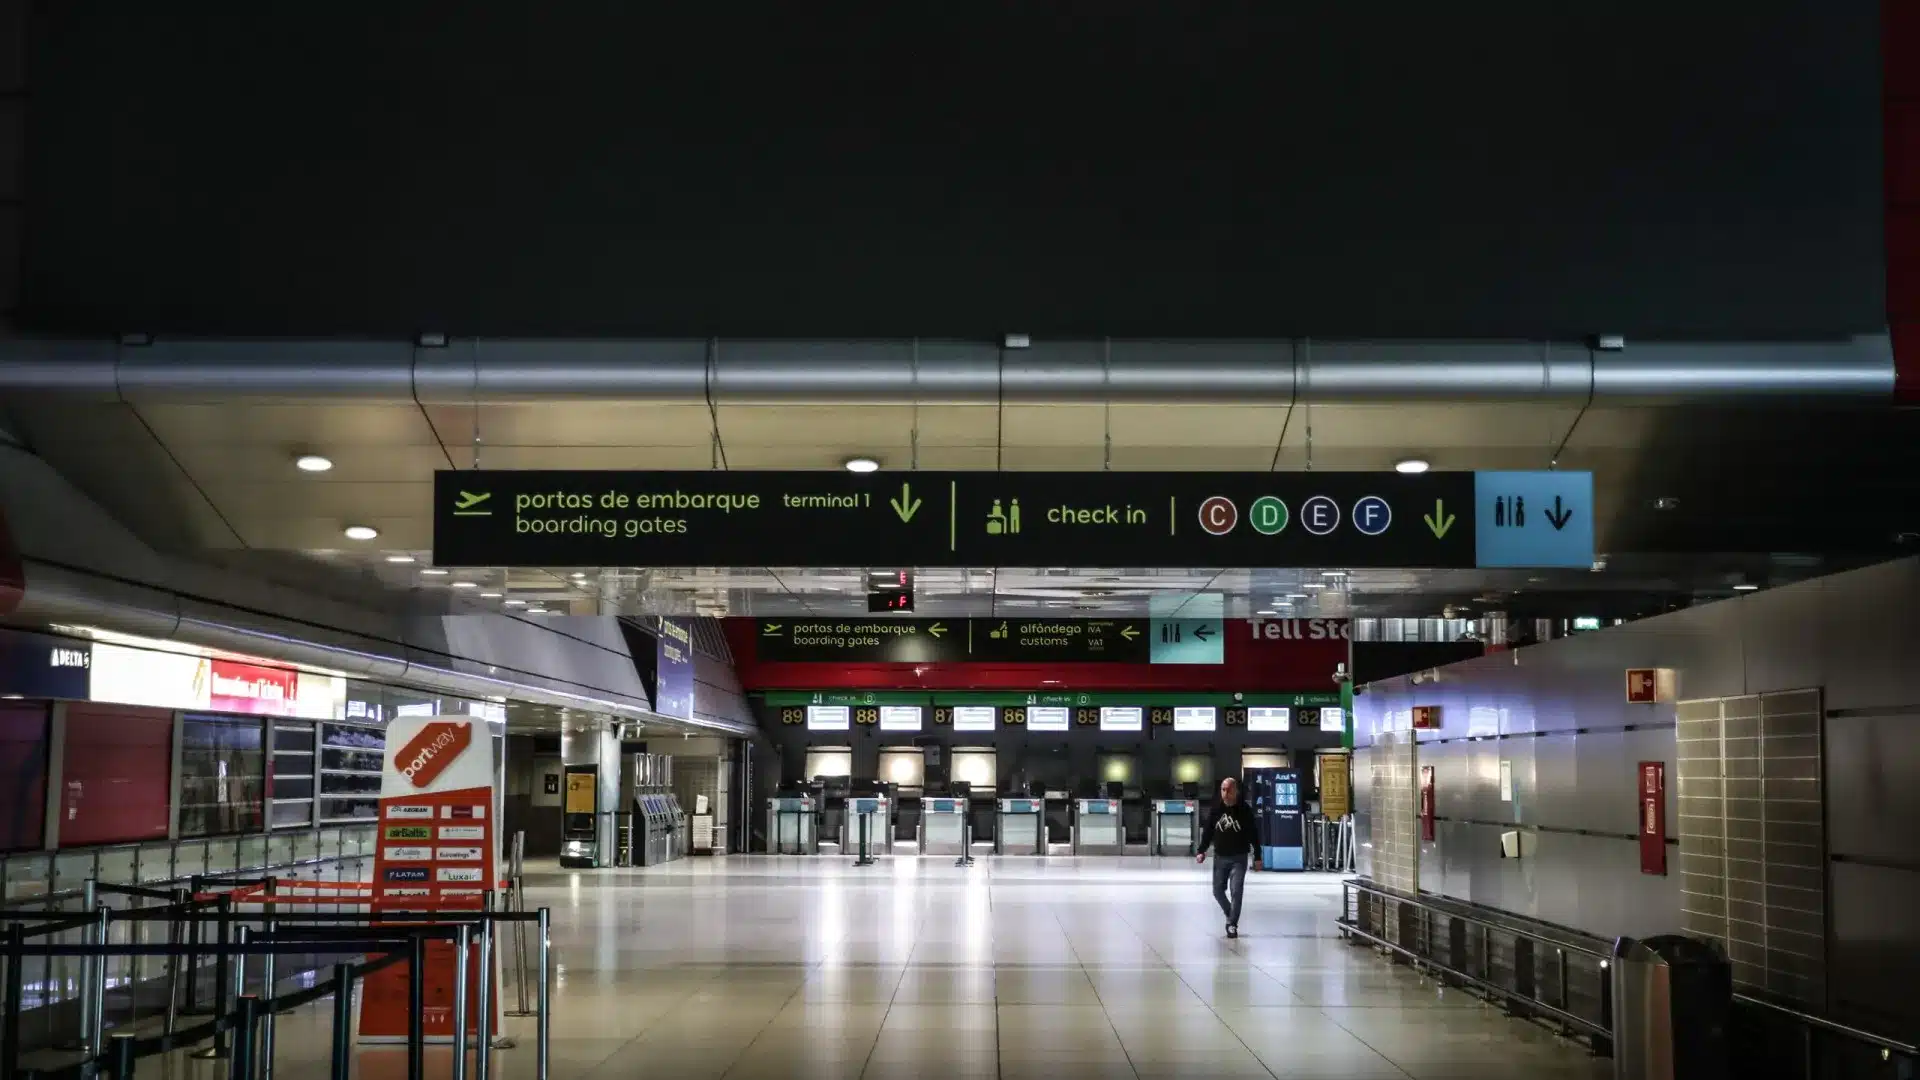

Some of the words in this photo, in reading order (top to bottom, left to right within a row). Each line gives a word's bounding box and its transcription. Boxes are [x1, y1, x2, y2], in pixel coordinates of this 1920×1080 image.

[515, 491, 593, 512] portas
[600, 490, 629, 509] de
[636, 490, 760, 513] embarque
[783, 493, 860, 508] terminal
[863, 493, 871, 508] 1
[1047, 505, 1118, 524] check
[1126, 504, 1146, 524] in
[1210, 505, 1228, 526] C
[1262, 505, 1278, 526] D
[1313, 505, 1328, 526] E
[1365, 505, 1380, 526] F
[515, 515, 618, 537] boarding
[624, 516, 687, 537] gates
[794, 624, 832, 636] portas
[836, 622, 850, 634] de
[854, 622, 916, 637] embarque
[1020, 622, 1081, 637] alfândega
[1247, 618, 1302, 640] Tell
[794, 636, 845, 648] boarding
[848, 637, 880, 648] gates
[1020, 636, 1068, 647] customs
[1088, 638, 1103, 646] VAT
[60, 652, 83, 667] DELTA
[782, 709, 803, 724] 89
[856, 709, 877, 724] 88
[935, 710, 954, 724] 87
[1004, 709, 1025, 724] 86
[1077, 709, 1098, 724] 85
[1152, 709, 1173, 724] 84
[1226, 710, 1247, 725] 83
[1299, 710, 1319, 725] 82
[402, 728, 456, 782] portway
[390, 828, 427, 838] airBaltic
[448, 872, 477, 881] Luxair
